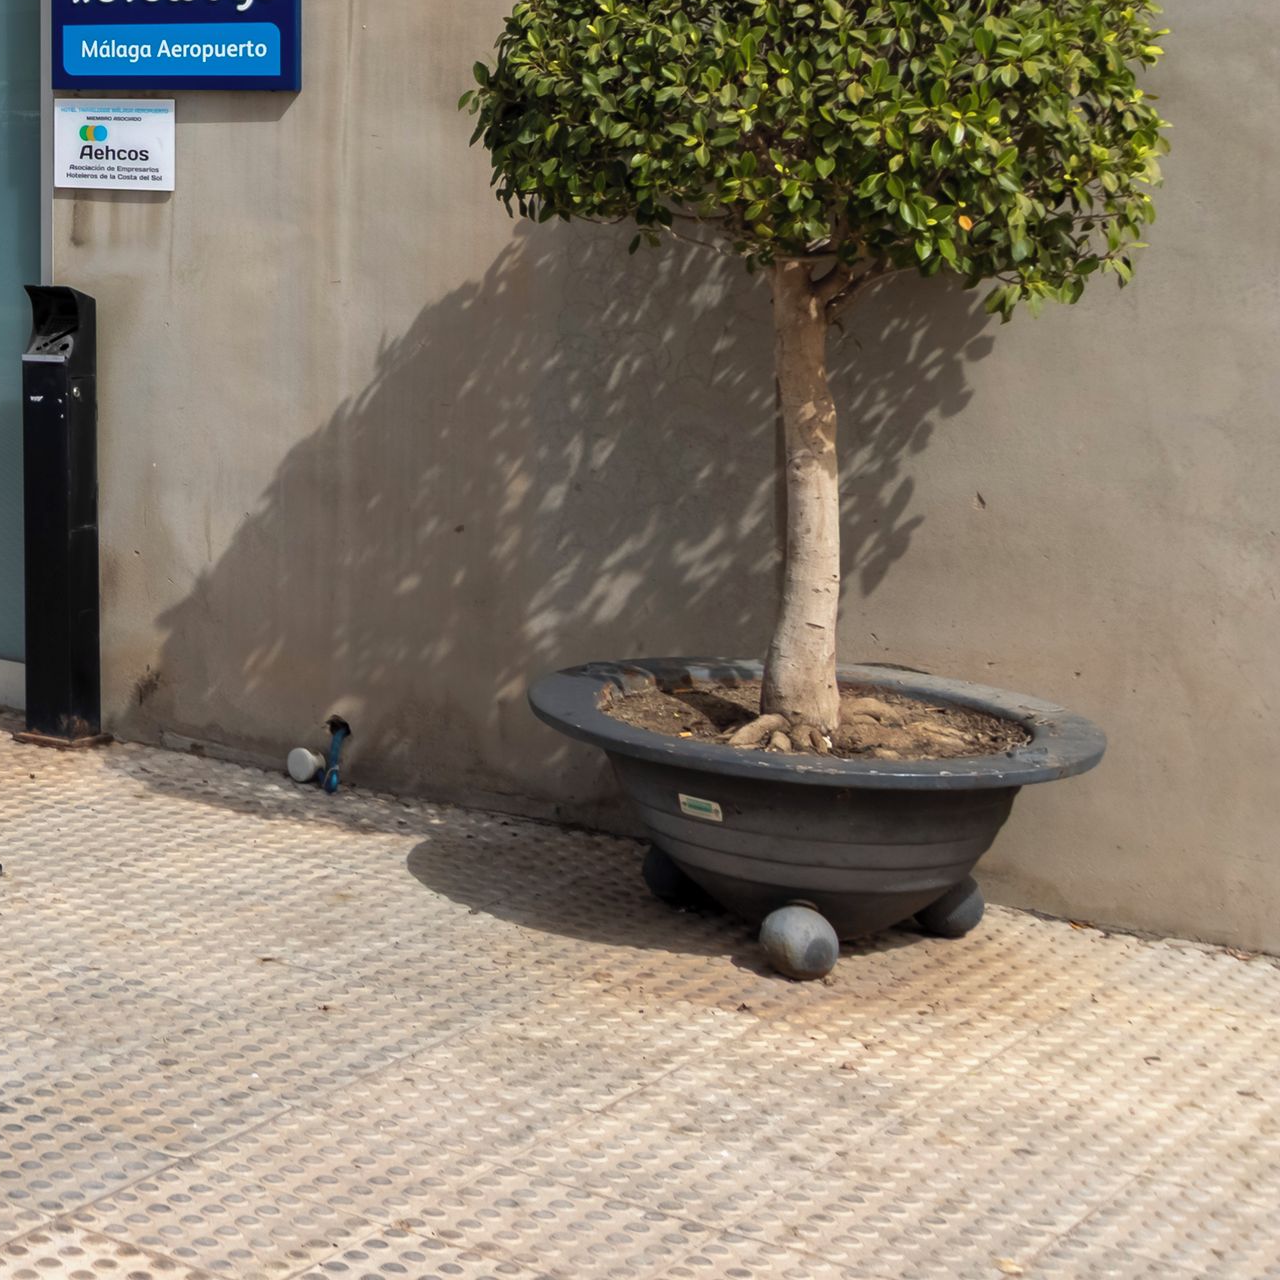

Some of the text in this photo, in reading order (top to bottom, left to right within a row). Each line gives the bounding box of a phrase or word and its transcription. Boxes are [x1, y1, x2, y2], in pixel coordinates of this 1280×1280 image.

[81, 39, 268, 63] Málaga Aeropuerto
[79, 145, 149, 161] Aehcos
